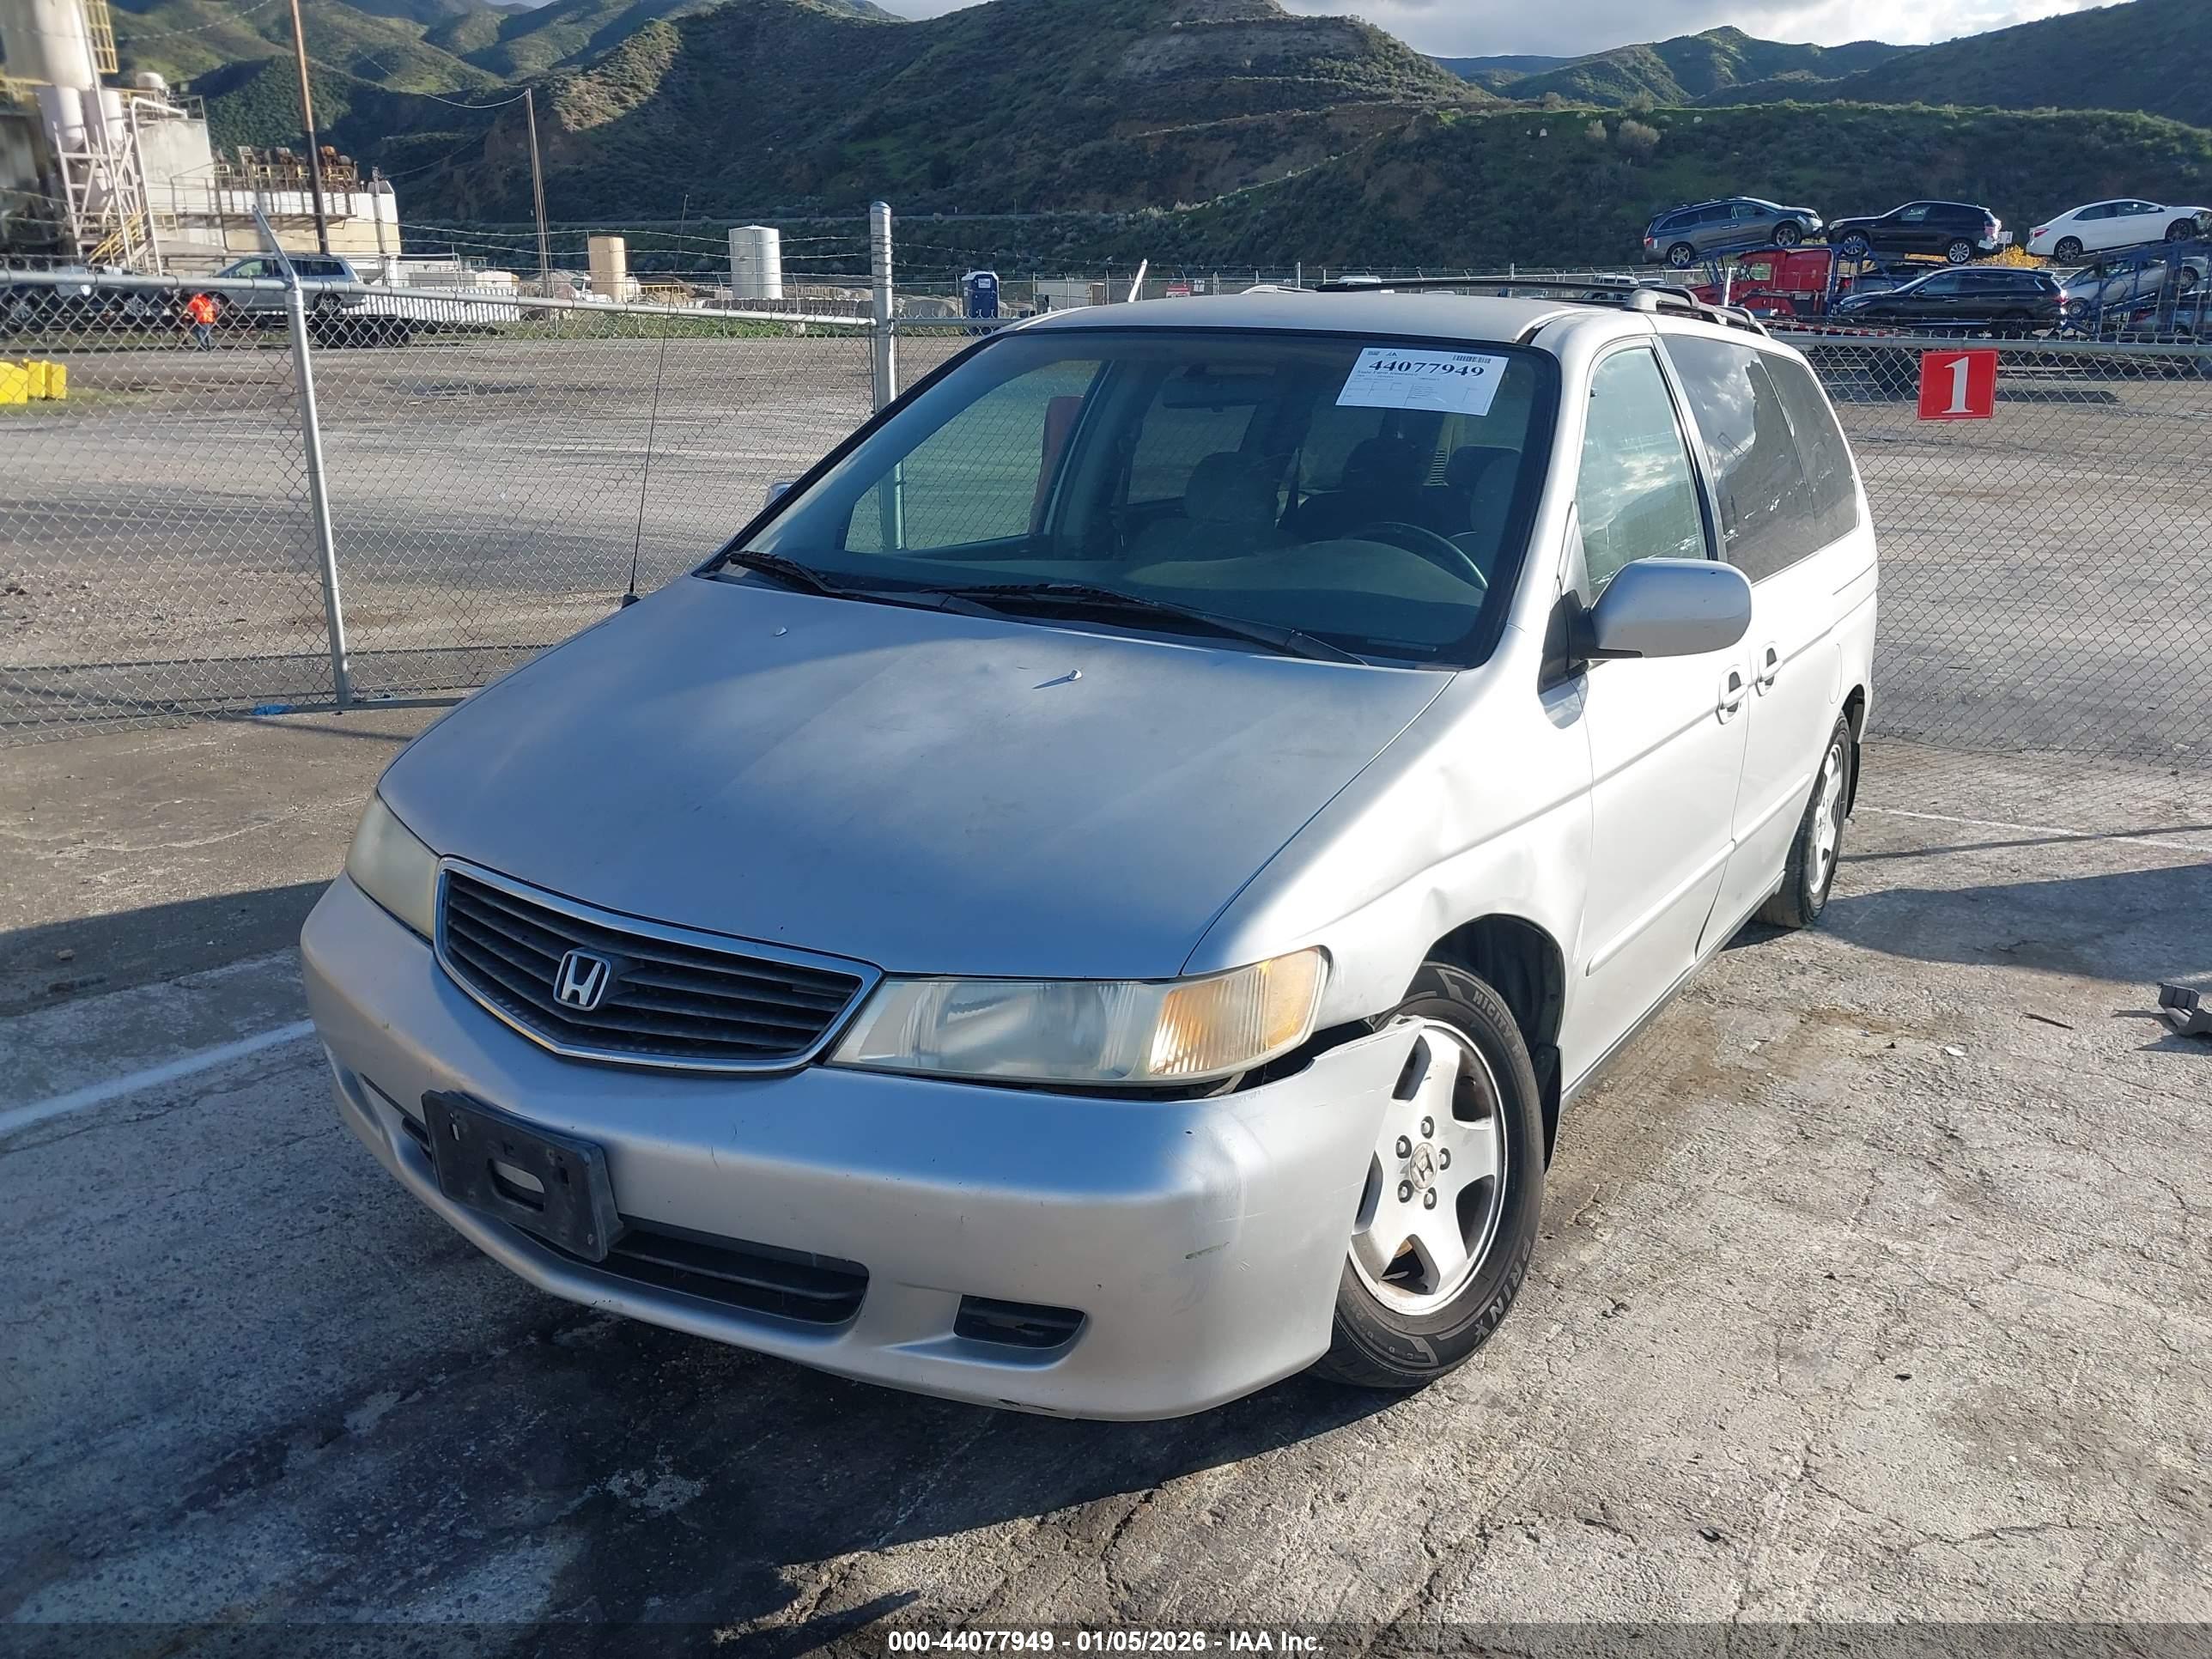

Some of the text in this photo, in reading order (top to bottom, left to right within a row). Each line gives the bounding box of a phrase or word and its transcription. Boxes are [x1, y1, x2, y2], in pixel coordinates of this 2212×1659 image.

[1368, 359, 1486, 378] 44077949
[1942, 356, 1974, 414] 1
[1471, 989, 1513, 1038] HICITY
[1474, 1236, 1532, 1346] PRINX
